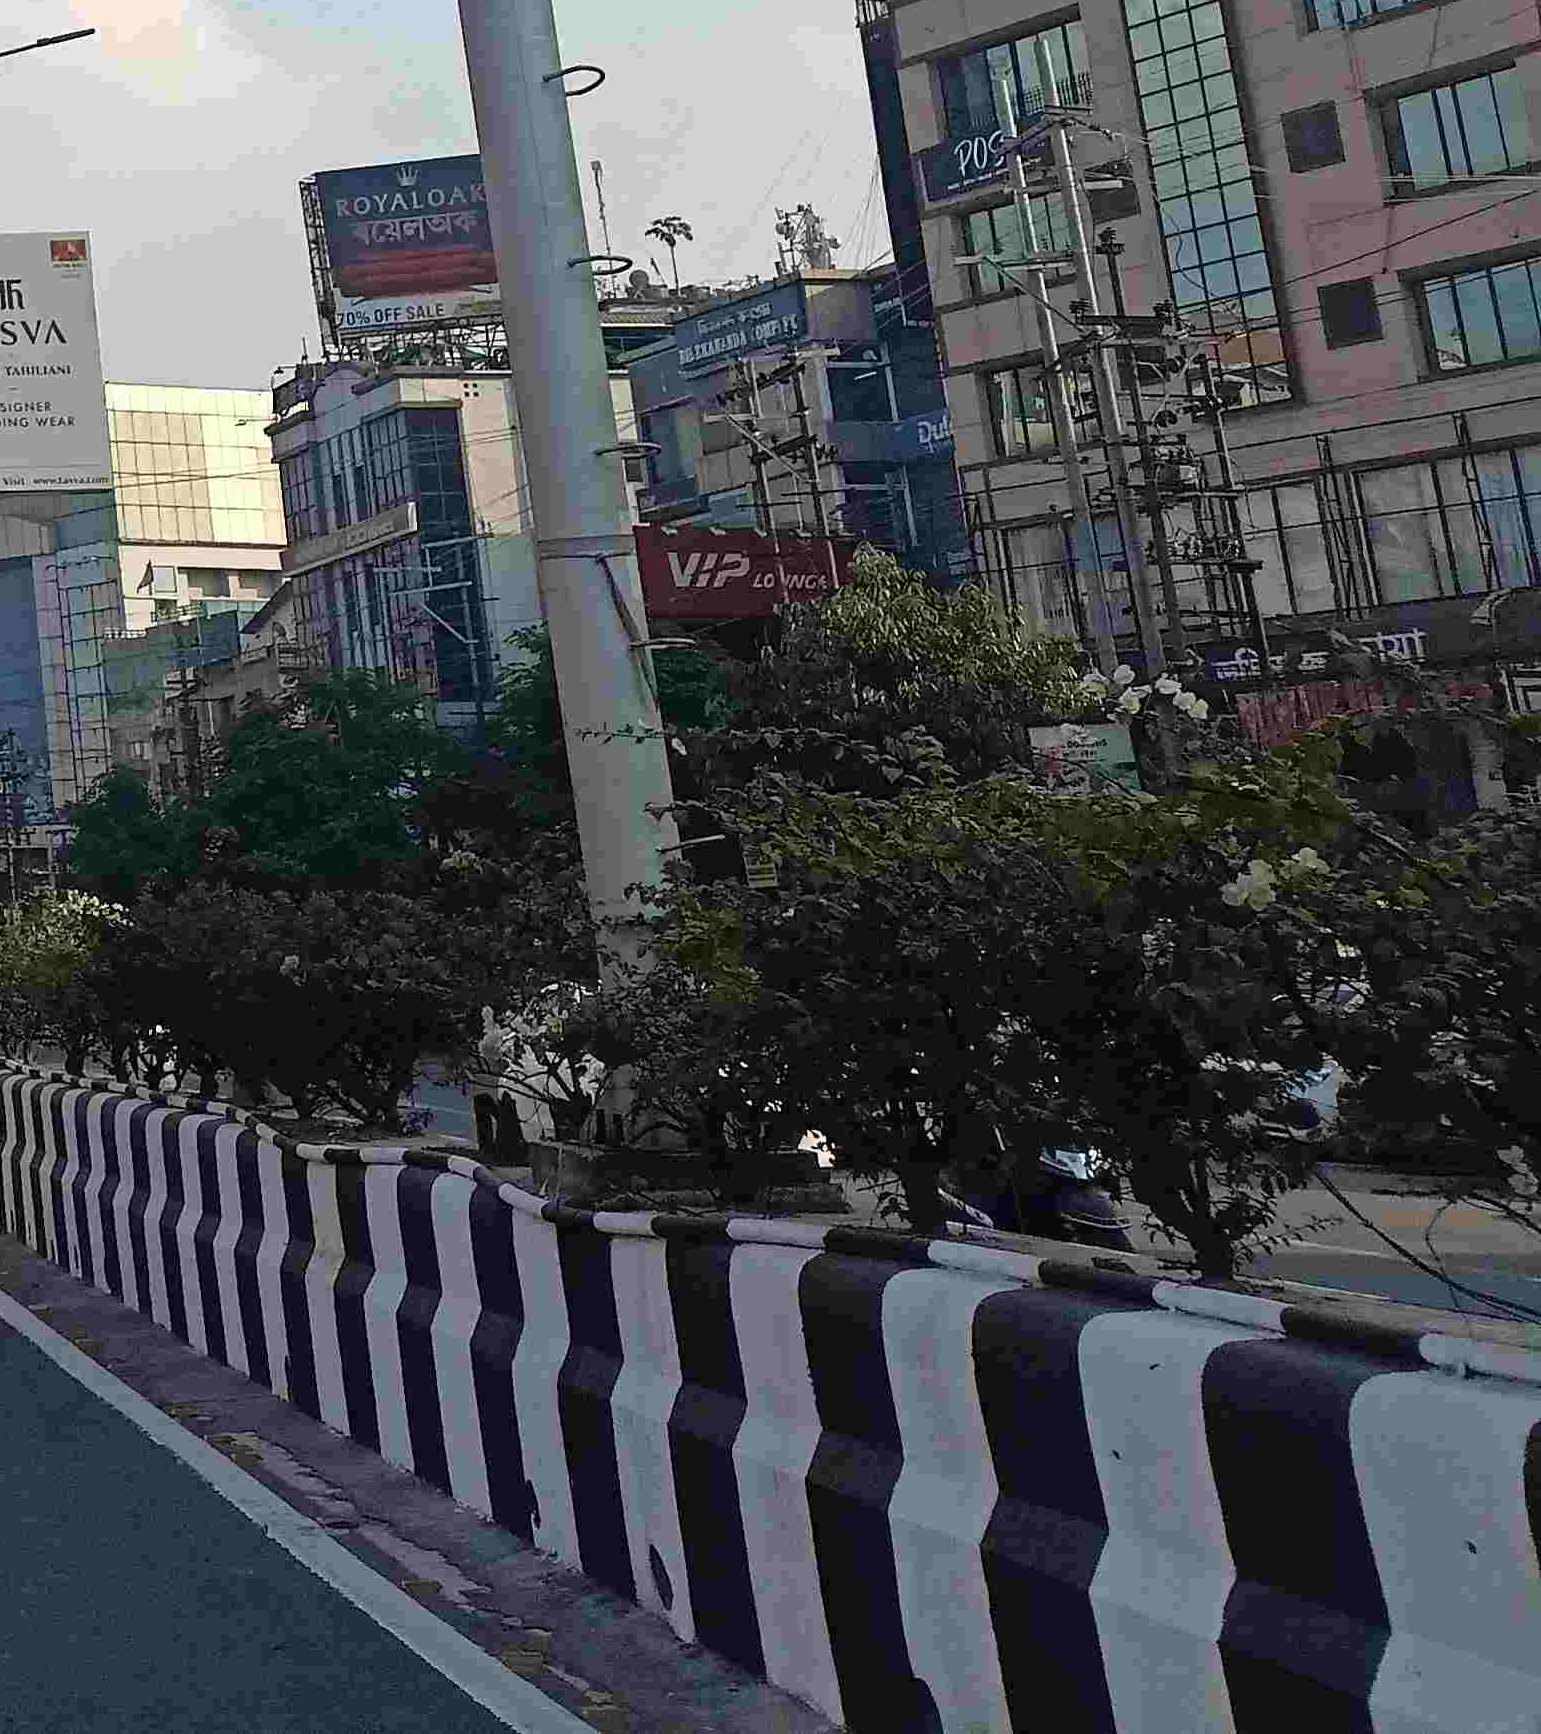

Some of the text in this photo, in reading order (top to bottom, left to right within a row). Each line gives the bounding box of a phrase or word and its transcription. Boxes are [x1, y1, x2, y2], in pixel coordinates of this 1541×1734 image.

[335, 184, 487, 218] ROYALOAK
[339, 303, 445, 327] 70% OFF SALE
[35, 415, 76, 428] WEAR
[667, 552, 750, 588] VIP
